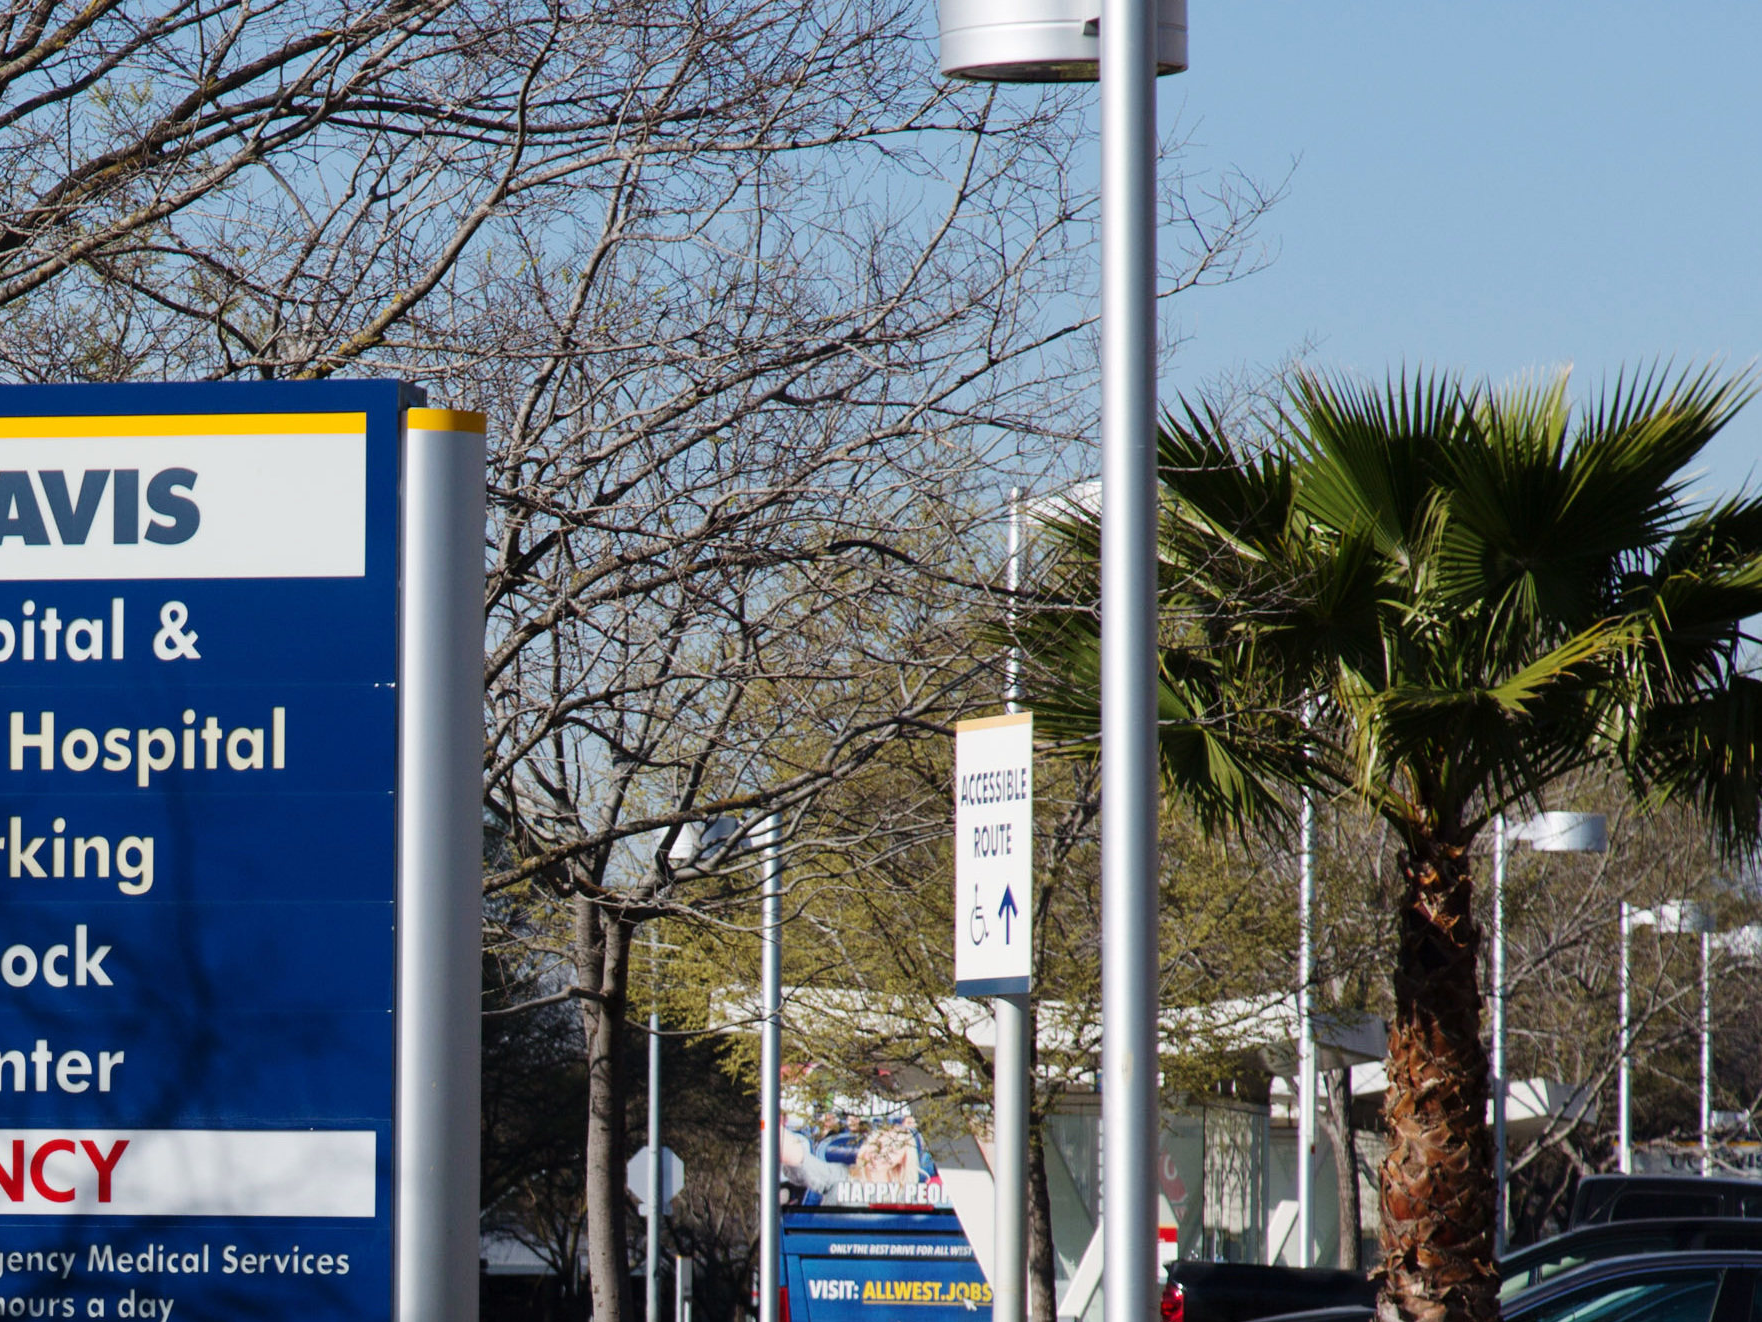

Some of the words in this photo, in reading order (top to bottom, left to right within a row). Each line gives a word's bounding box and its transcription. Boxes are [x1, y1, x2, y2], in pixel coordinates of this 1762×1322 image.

[152, 600, 202, 662] &
[9, 706, 286, 788] Hospital
[961, 768, 1026, 806] ACCESSIBLE
[973, 823, 1012, 858] ROUTE
[838, 1182, 899, 1204] HAPPY
[87, 1243, 209, 1274] Medical
[222, 1244, 350, 1275] Services
[830, 1243, 853, 1255] ONLY
[852, 1244, 868, 1255] THE
[869, 1244, 890, 1256] BEST
[890, 1244, 915, 1256] DRIVE
[916, 1245, 934, 1256] FOR
[934, 1245, 949, 1256] ALL
[808, 1280, 859, 1300] VISIT:
[863, 1280, 993, 1302] ALLWEST.JOBS
[86, 1297, 105, 1318] a
